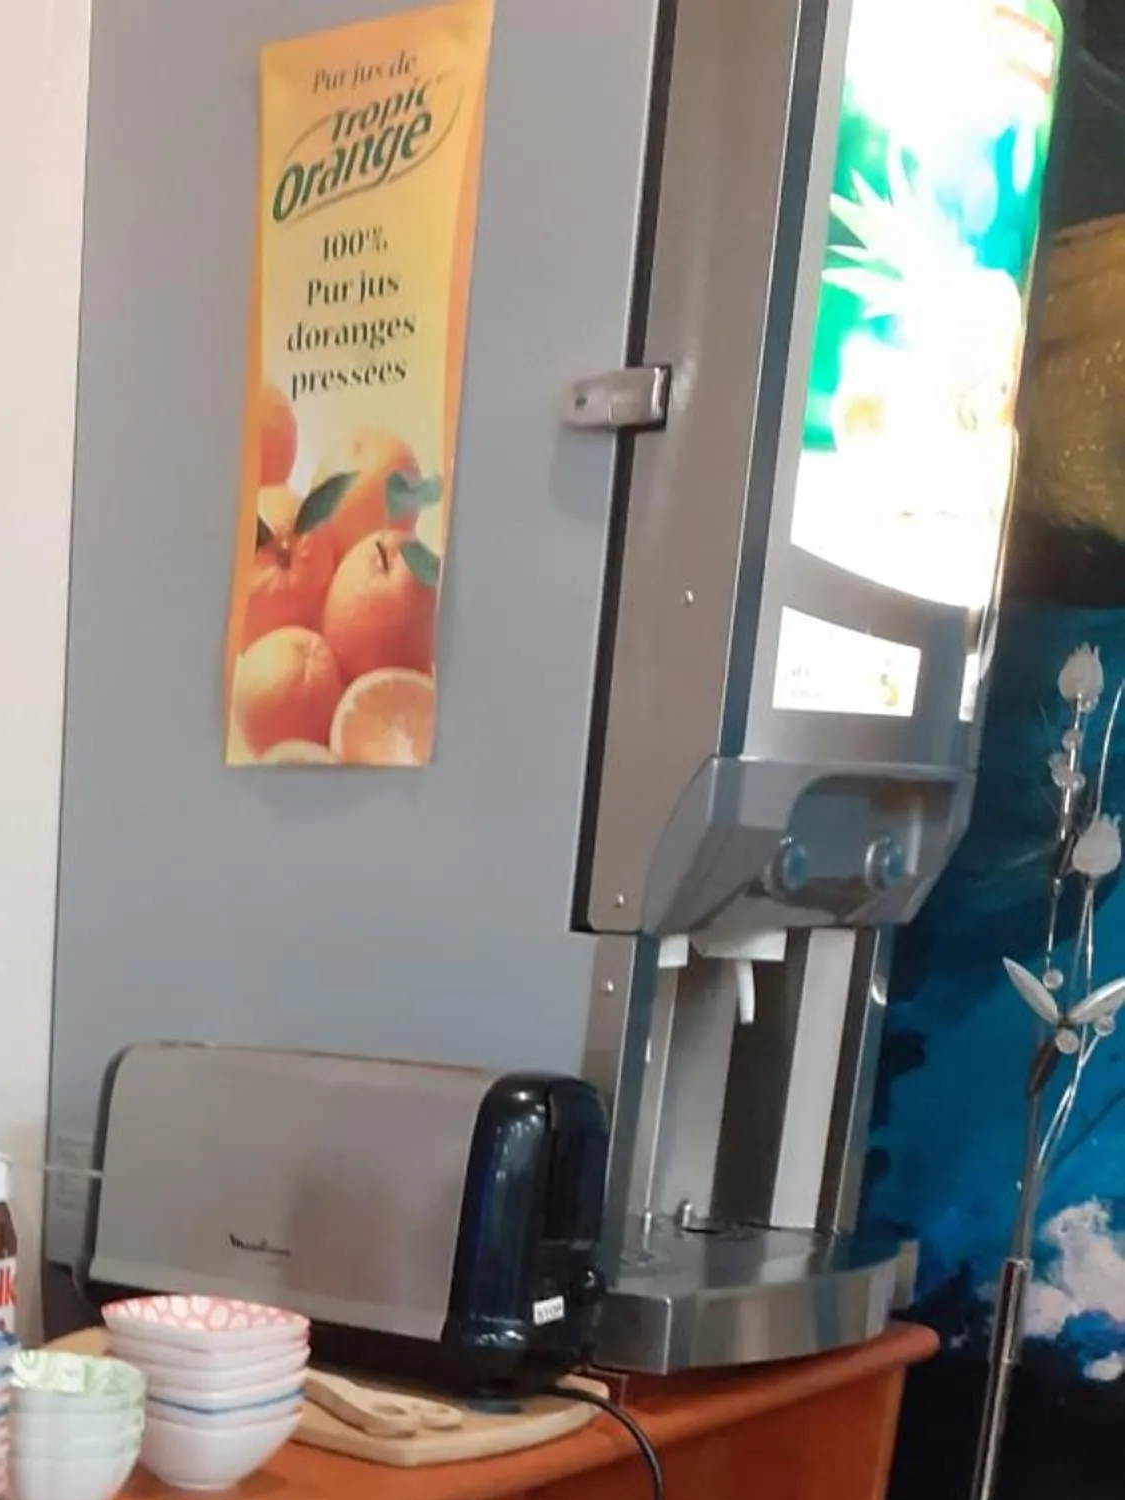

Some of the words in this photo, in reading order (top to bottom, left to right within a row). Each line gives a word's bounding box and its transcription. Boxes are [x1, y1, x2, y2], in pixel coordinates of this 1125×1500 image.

[389, 49, 417, 77] de
[331, 76, 429, 143] Tropic
[273, 111, 432, 223] Orange
[323, 225, 388, 262] 100%
[308, 279, 354, 307] Pur
[360, 269, 400, 305] jus
